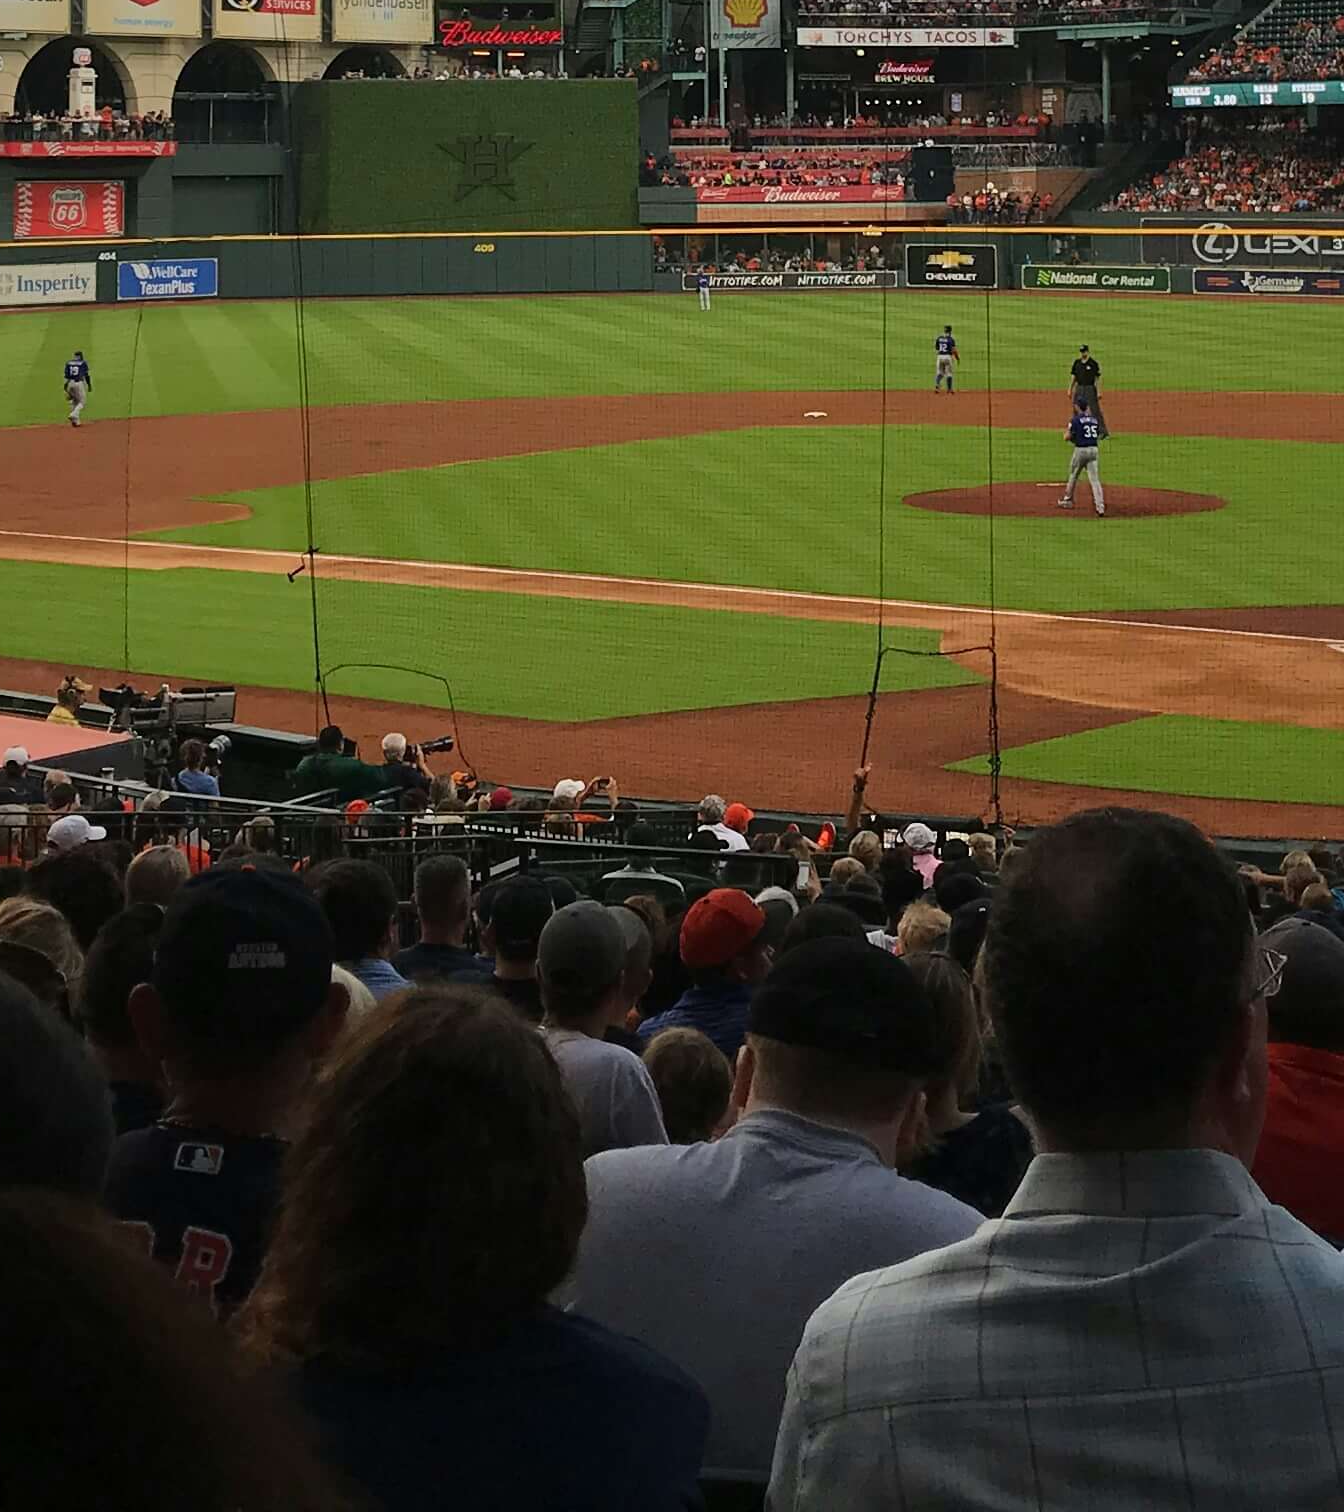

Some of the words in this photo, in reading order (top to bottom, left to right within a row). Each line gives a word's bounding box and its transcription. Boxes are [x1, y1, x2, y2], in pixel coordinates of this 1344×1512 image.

[265, 0, 312, 11] SERVICES
[439, 20, 562, 46] Budweiser
[836, 31, 913, 44] TORCHYS
[925, 30, 978, 43] TACOS
[761, 186, 841, 202] Budweiser
[56, 204, 80, 221] 66
[151, 266, 198, 279] WellCare
[925, 272, 977, 282] CHEVROLET
[1050, 270, 1097, 285] National
[1101, 274, 1120, 286] Car
[1120, 274, 1155, 287] Rental
[17, 274, 90, 294] Insperity
[797, 273, 876, 287] NITTOTIRE.COM
[1256, 275, 1304, 287] Germania
[140, 281, 195, 295] TexanPlus
[1084, 425, 1098, 438] 35
